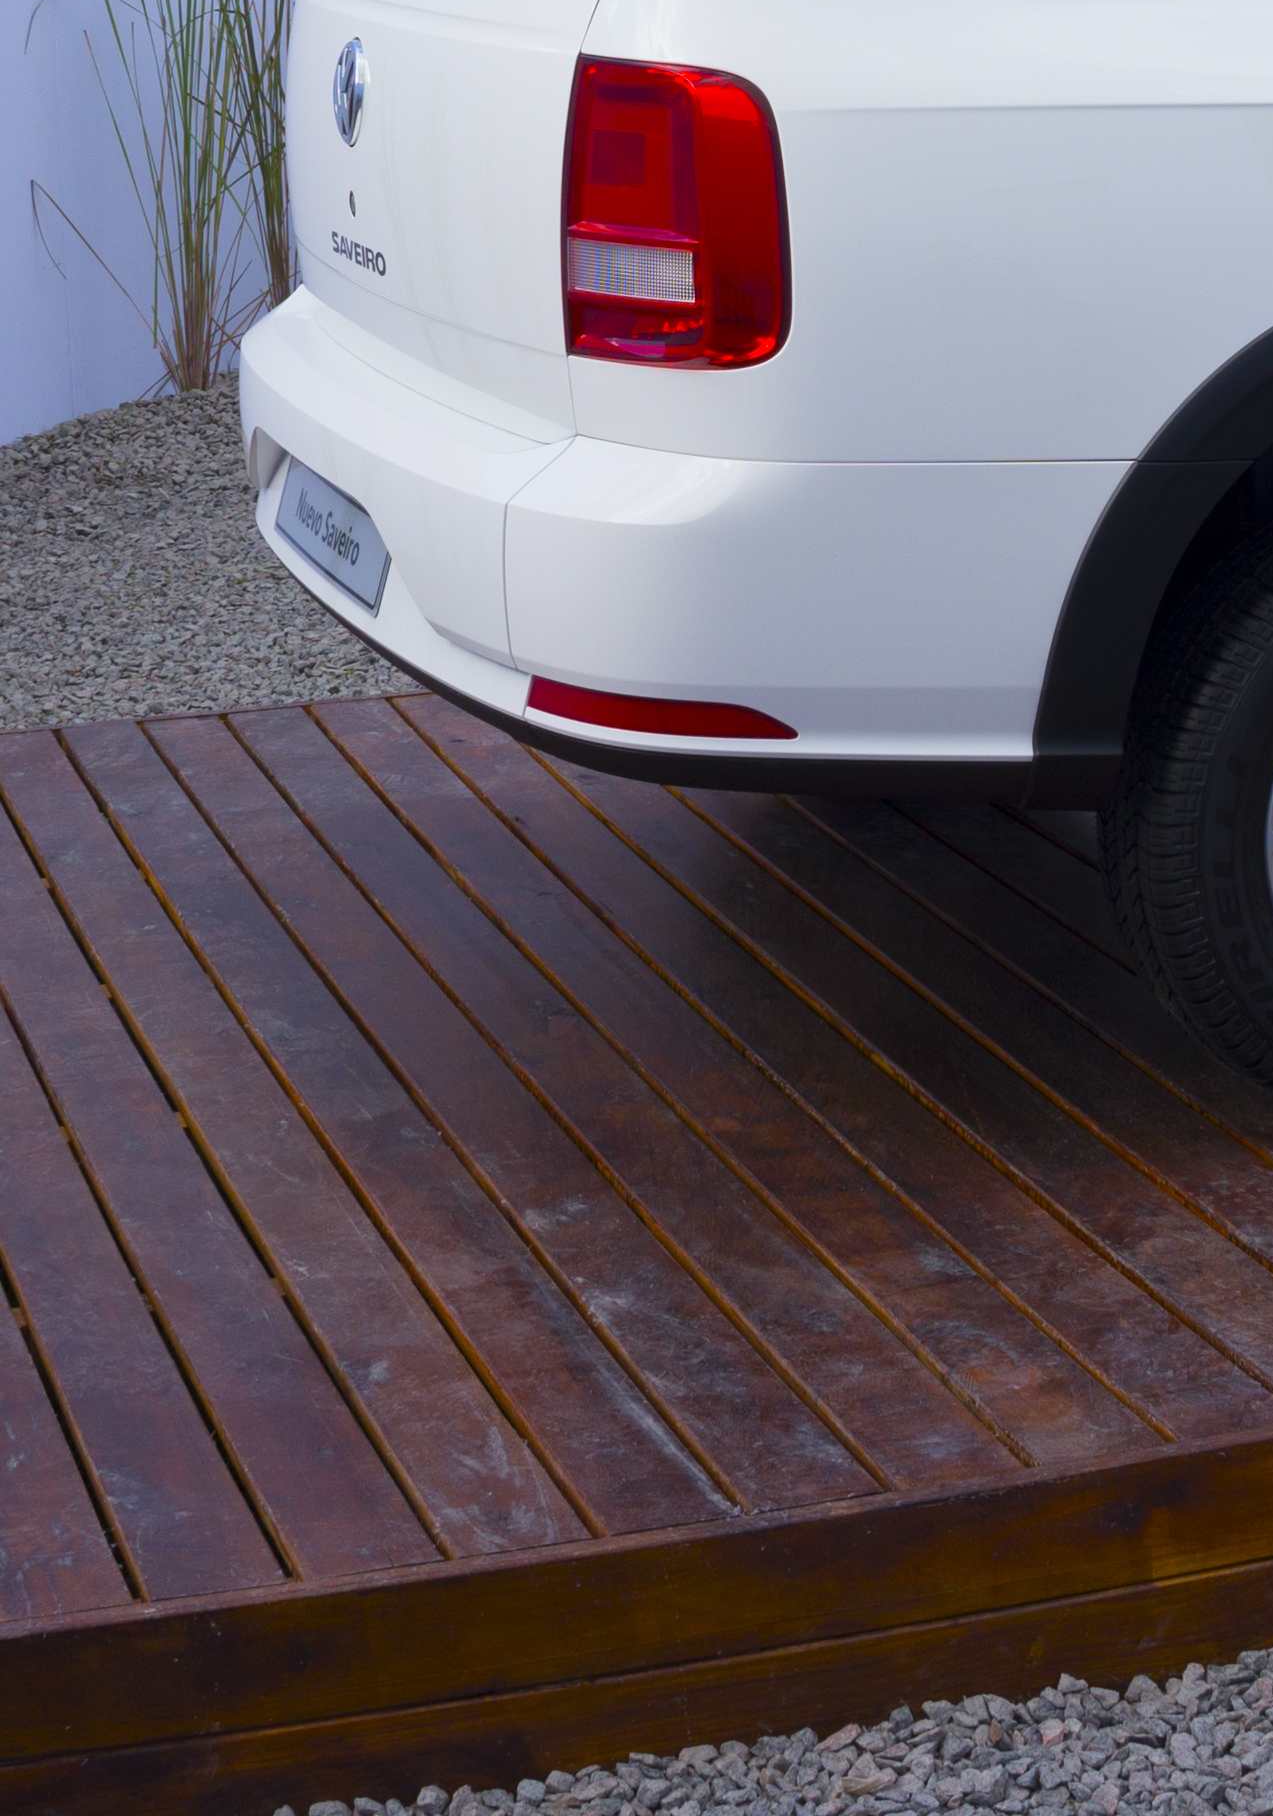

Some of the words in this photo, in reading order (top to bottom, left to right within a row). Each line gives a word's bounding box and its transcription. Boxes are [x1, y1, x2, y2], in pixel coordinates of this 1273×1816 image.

[331, 230, 387, 277] SAVEIRO
[295, 488, 323, 537] Nuevo
[321, 510, 360, 566] Saveiro
